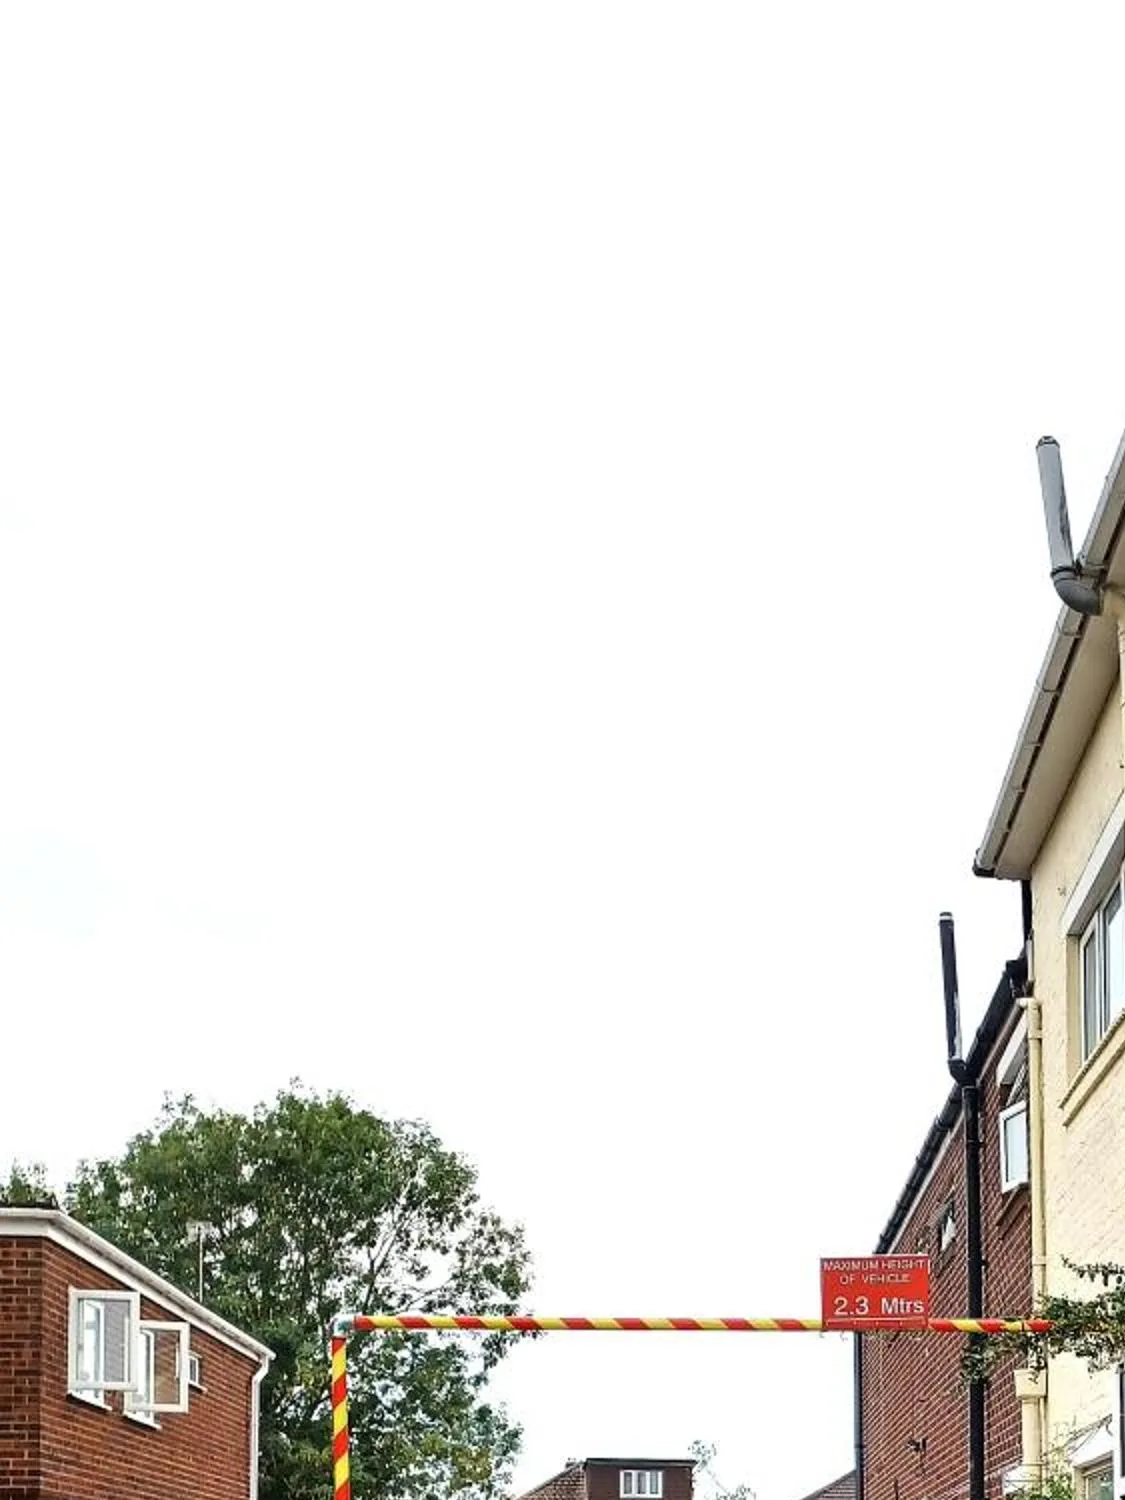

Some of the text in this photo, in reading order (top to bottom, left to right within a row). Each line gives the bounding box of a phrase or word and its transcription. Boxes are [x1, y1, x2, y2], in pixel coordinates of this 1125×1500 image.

[823, 1259, 924, 1271] MAXIMUM HEIGHT
[839, 1273, 912, 1285] OF VEHICLE
[833, 1296, 924, 1316] 2.3 Mtrs
